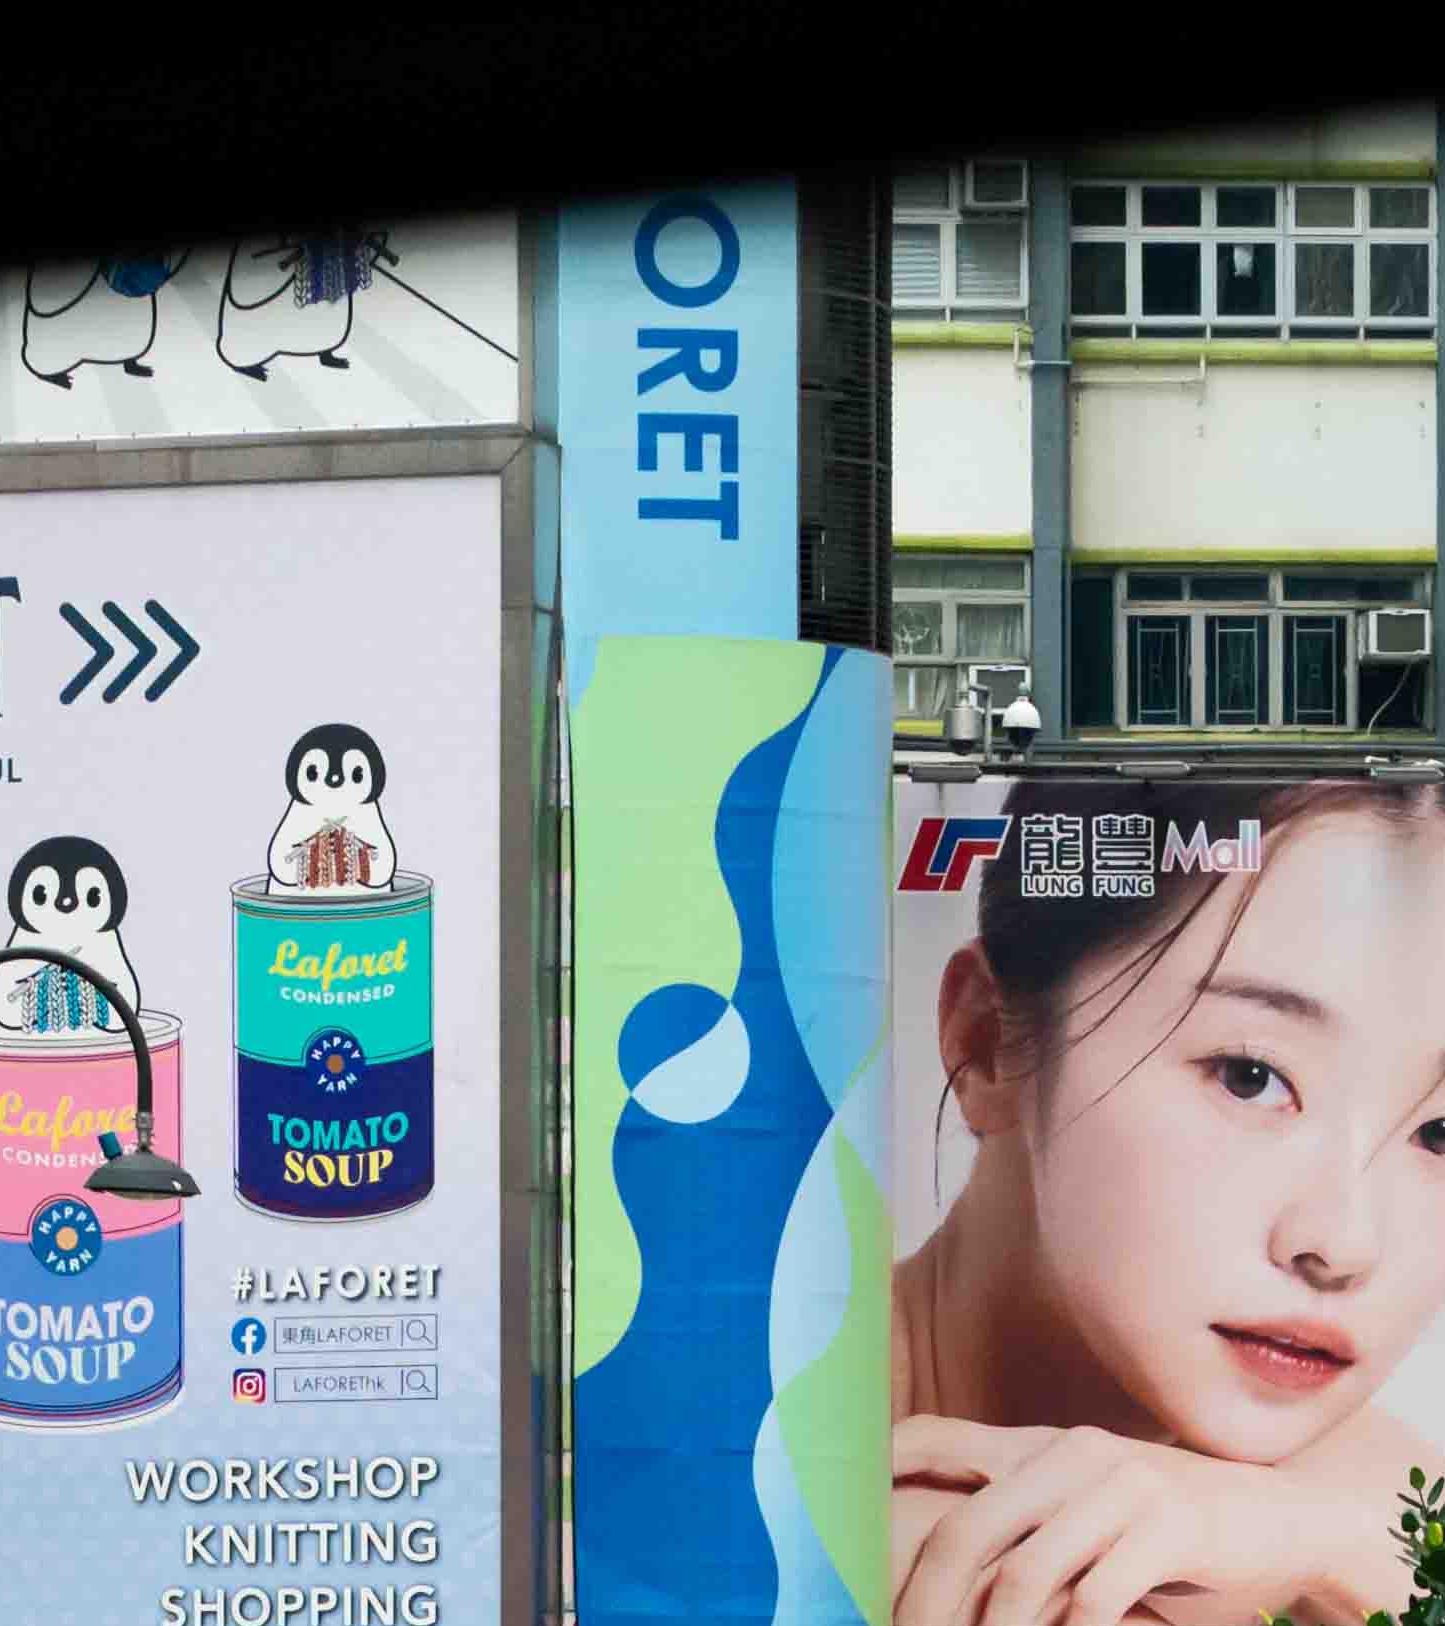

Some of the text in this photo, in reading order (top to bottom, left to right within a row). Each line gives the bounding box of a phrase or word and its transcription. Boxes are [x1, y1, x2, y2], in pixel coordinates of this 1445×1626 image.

[1160, 818, 1262, 874] Mall
[1021, 875, 1155, 897] LUNG FUNG
[267, 938, 409, 992] Laforet
[279, 983, 397, 1006] CONDENSED
[310, 1035, 361, 1062] HAPPY
[316, 1071, 358, 1093] YARN
[266, 1111, 410, 1151] TOMATO
[283, 1149, 394, 1188] SOUP
[37, 1206, 98, 1235] HAPPY
[45, 1248, 94, 1274] YARN
[232, 1264, 442, 1304] #LAFORET
[4, 1341, 136, 1385] SOUP
[124, 1455, 440, 1503] WORKSHOP
[184, 1519, 440, 1566] KNITTING
